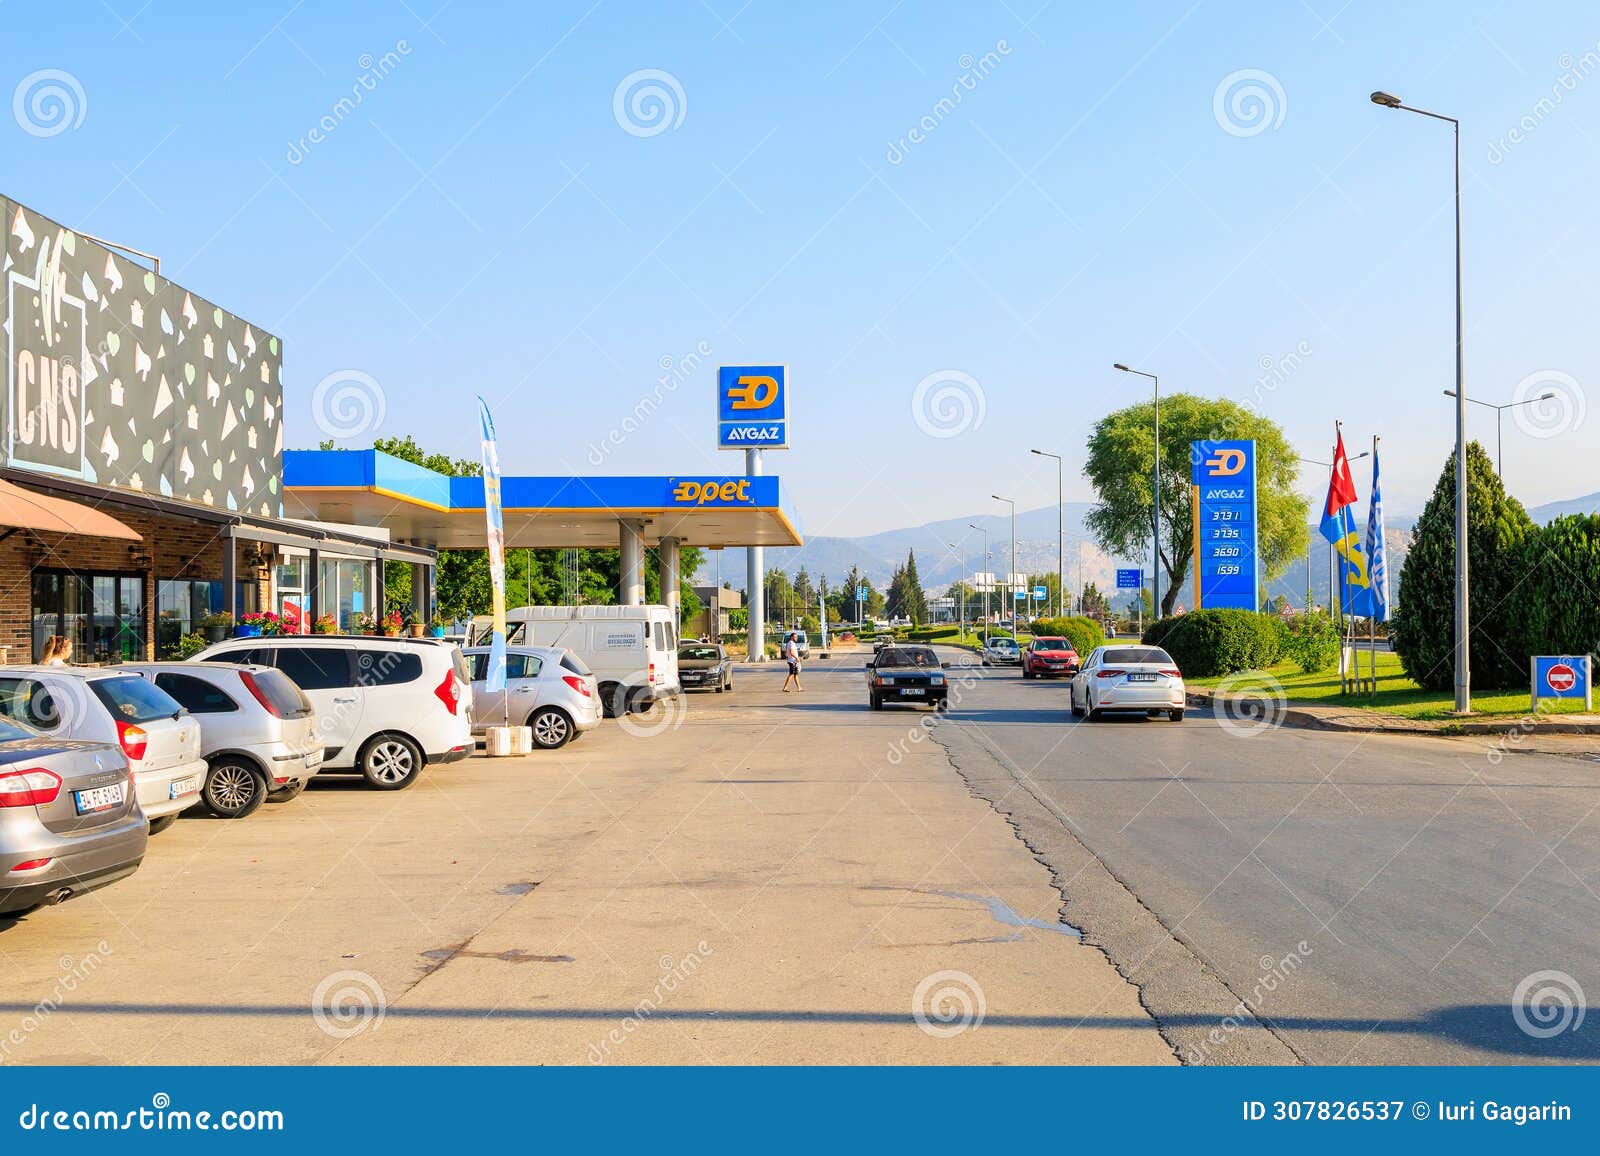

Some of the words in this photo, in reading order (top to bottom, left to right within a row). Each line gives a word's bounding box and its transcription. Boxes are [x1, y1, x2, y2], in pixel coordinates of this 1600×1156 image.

[18, 349, 78, 454] CNS
[727, 427, 779, 440] AYGAZ
[1206, 489, 1245, 499] AYGAZ
